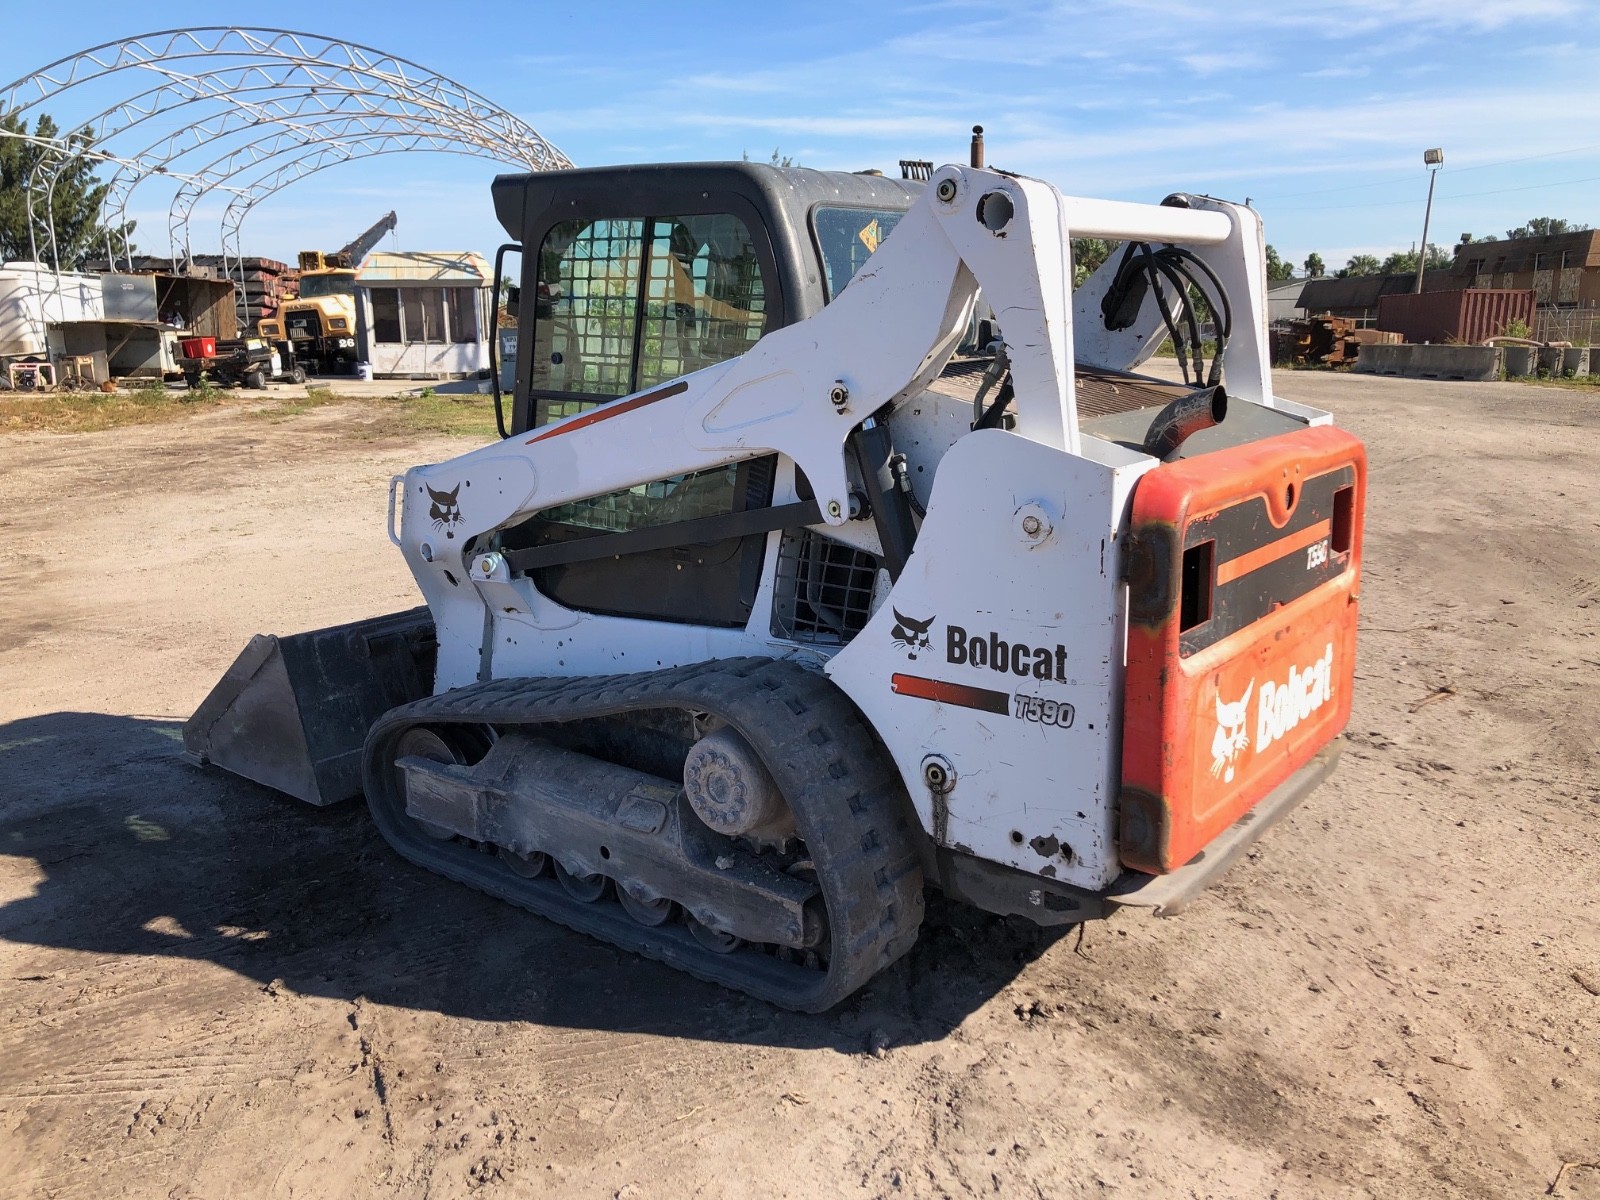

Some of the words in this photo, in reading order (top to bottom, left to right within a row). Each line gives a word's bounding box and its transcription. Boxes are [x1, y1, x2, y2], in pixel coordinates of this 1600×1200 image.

[339, 338, 355, 348] 26
[1307, 539, 1328, 570] T590
[947, 625, 1067, 684] Bobcat
[1014, 694, 1075, 729] T590
[1256, 643, 1333, 753] Bobcat
